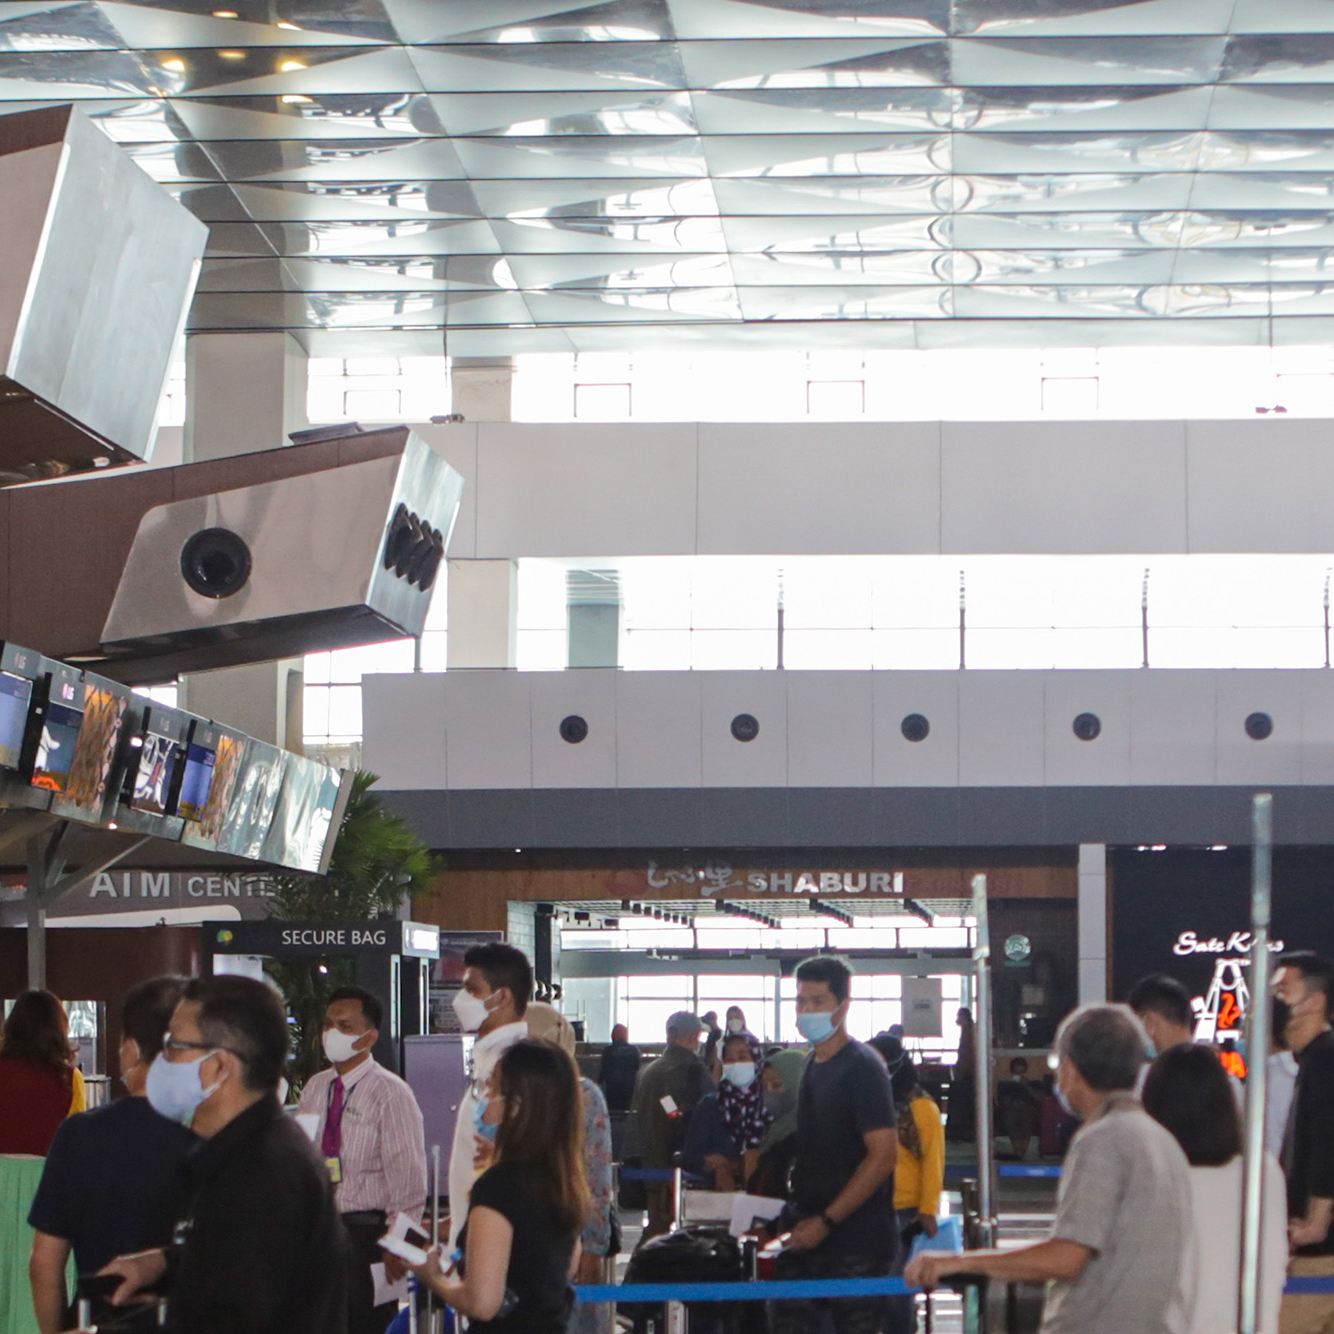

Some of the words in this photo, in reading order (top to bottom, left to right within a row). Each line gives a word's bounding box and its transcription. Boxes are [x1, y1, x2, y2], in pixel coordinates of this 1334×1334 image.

[187, 876, 279, 898] CENTE
[747, 871, 904, 894] SHABURI
[282, 930, 346, 945] SECURE
[351, 930, 386, 945] BAG
